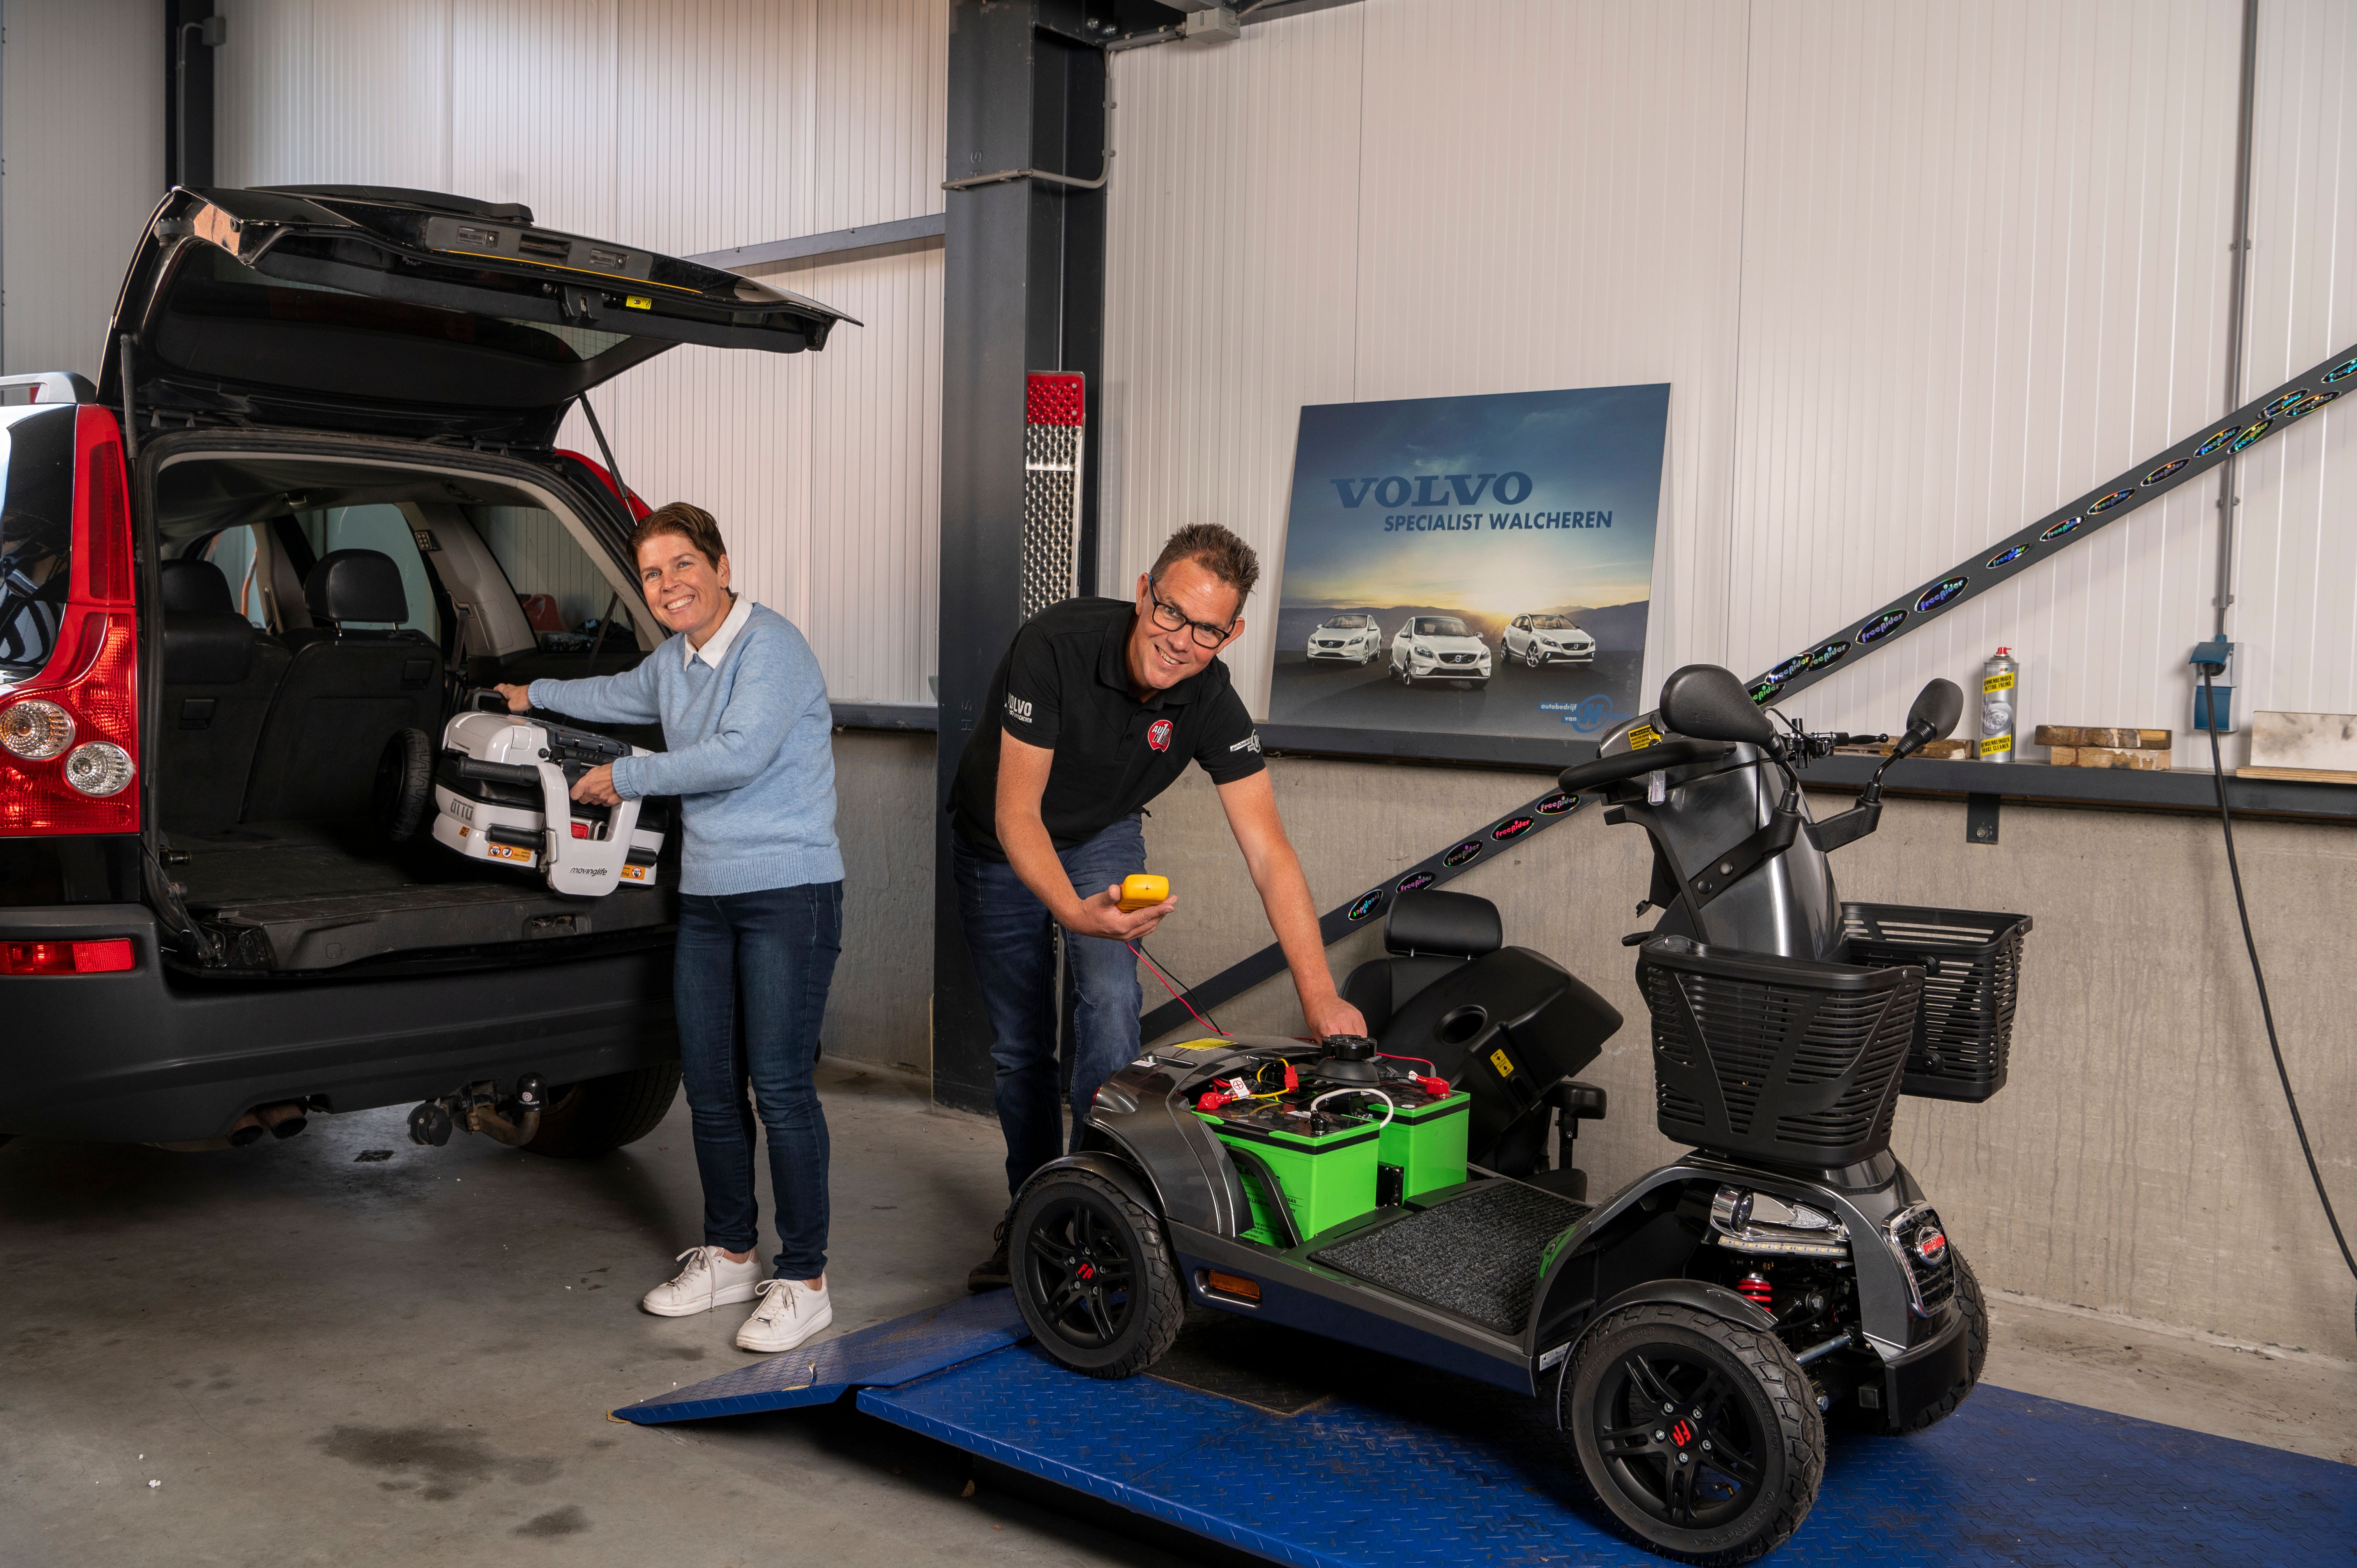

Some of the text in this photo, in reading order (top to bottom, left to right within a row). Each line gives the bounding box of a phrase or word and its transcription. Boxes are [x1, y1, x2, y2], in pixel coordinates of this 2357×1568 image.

[2328, 360, 2357, 381] FreeRi
[1330, 471, 1533, 509] VOLVO
[1384, 511, 1613, 532] SPECIALIST WALCHEREN
[2047, 516, 2081, 539] FreeRide
[1806, 644, 1847, 671] reeRider
[1008, 692, 1032, 717] VOLVO
[1541, 703, 1577, 712] autobedrijf
[1635, 727, 1652, 735] WARNI
[1232, 738, 1251, 750] autobedrijf
[569, 867, 608, 876] movinglife
[1077, 1263, 1094, 1279] FR
[1673, 1420, 1691, 1446] FR
